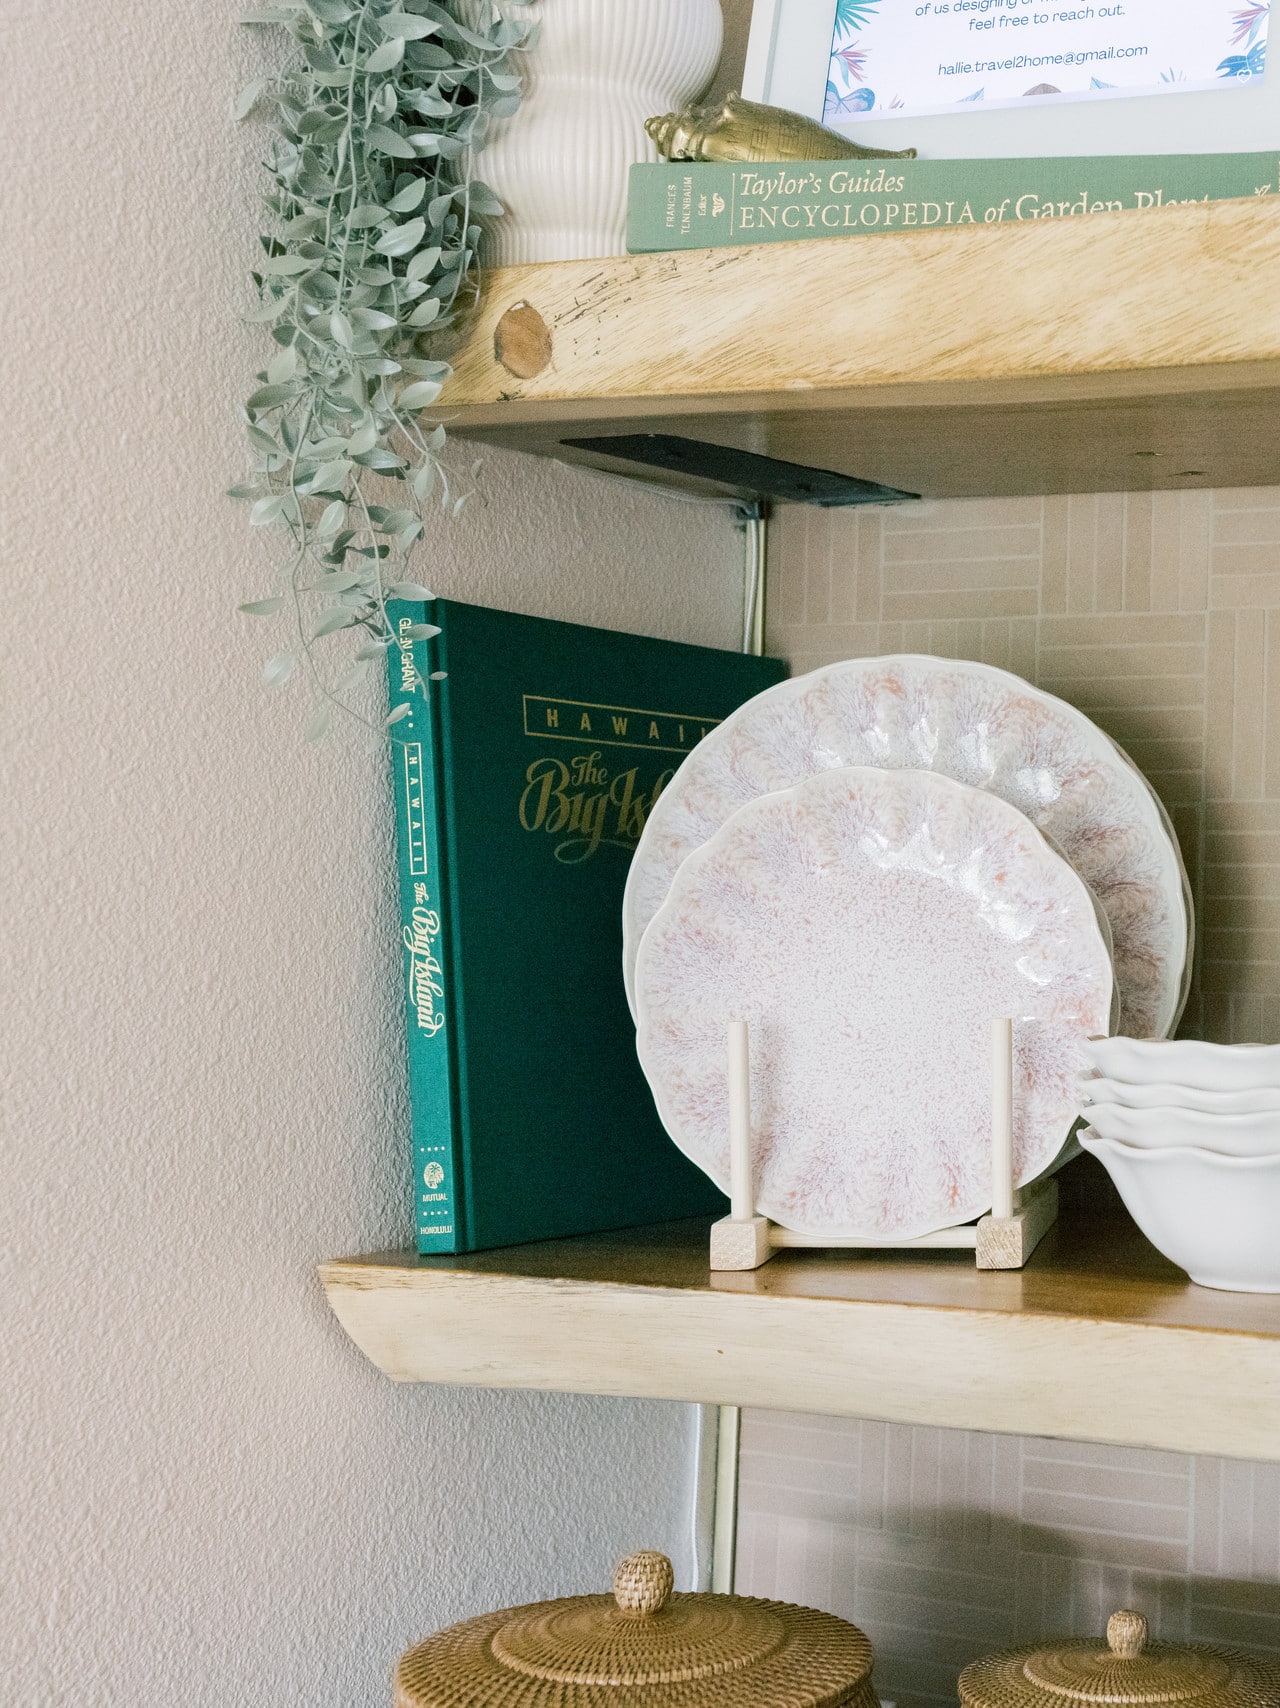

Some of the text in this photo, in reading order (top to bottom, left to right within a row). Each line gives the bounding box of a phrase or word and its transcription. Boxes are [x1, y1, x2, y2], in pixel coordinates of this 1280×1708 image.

[915, 3, 931, 17] of
[934, 2, 949, 15] us
[953, 0, 1017, 13] designing
[969, 4, 1126, 31] feel free to reach out.
[938, 44, 1148, 76] hallie.travel2home@gmail.com
[829, 168, 905, 194] Guides
[666, 183, 677, 228] FRANCES
[680, 176, 693, 235] TENENBAUM
[738, 200, 975, 229] ENCYCLOPEDIA
[984, 198, 1011, 224] of
[1015, 190, 1124, 221] Garden
[401, 652, 416, 694] GRANT
[571, 751, 609, 786] The
[409, 756, 423, 862] HAWAII
[519, 757, 637, 865] Big
[414, 881, 430, 905] The
[415, 956, 445, 1038] Island
[422, 1193, 449, 1202] MUTUAL
[420, 1226, 453, 1235] HONOLULU
